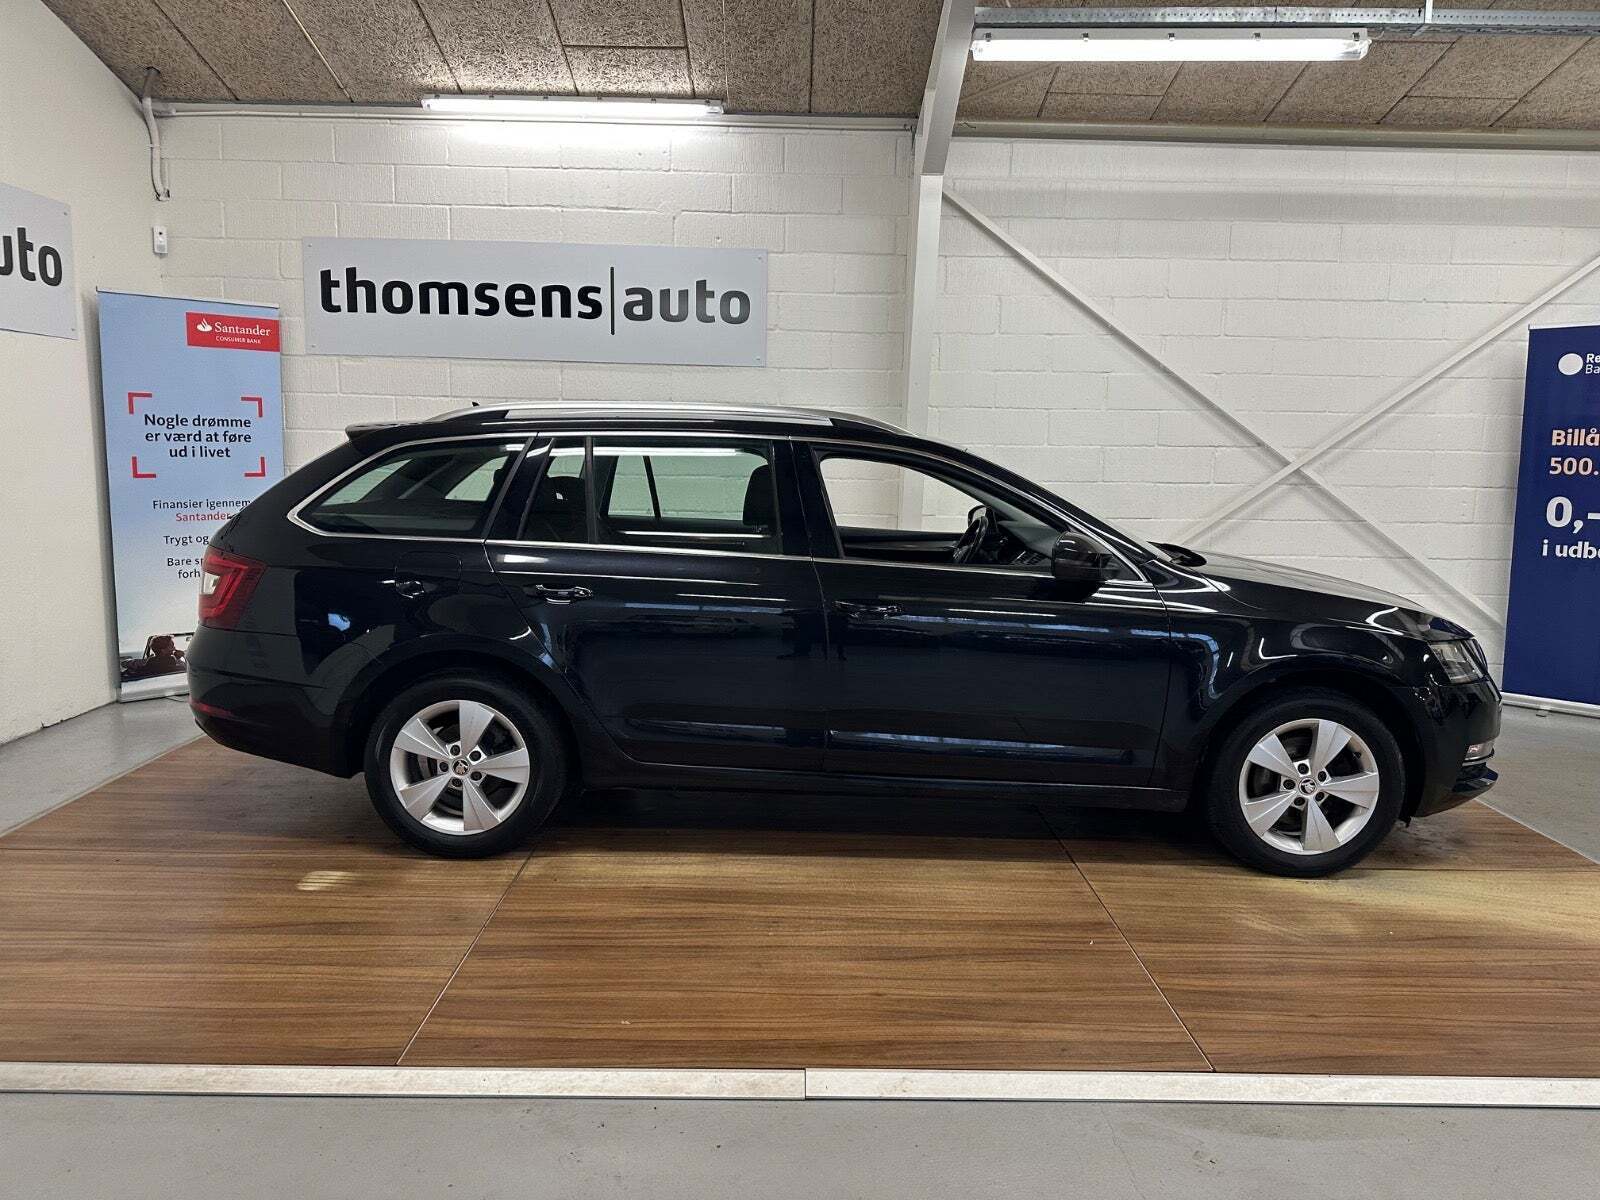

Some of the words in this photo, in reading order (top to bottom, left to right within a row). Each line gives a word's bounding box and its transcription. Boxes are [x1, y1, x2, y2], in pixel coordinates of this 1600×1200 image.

[320, 267, 603, 320] thomsens
[623, 279, 751, 325] auto
[214, 321, 271, 337] Santander
[215, 336, 246, 344] CONSUMER
[144, 413, 189, 430] Nogle
[192, 415, 251, 428] drømme
[145, 432, 159, 442] er
[164, 430, 202, 443] værd
[205, 432, 220, 442] at
[222, 430, 252, 443] føre
[1551, 428, 1600, 447] Billå
[169, 446, 187, 458] ud
[191, 446, 195, 458] i
[200, 446, 231, 458] livet
[1549, 457, 1599, 476] 500.
[153, 500, 203, 510] Finansier
[163, 535, 193, 546] Trygt
[195, 535, 209, 545] og
[1542, 539, 1549, 556] i
[1555, 541, 1600, 559] udb
[167, 557, 192, 567] Bare
